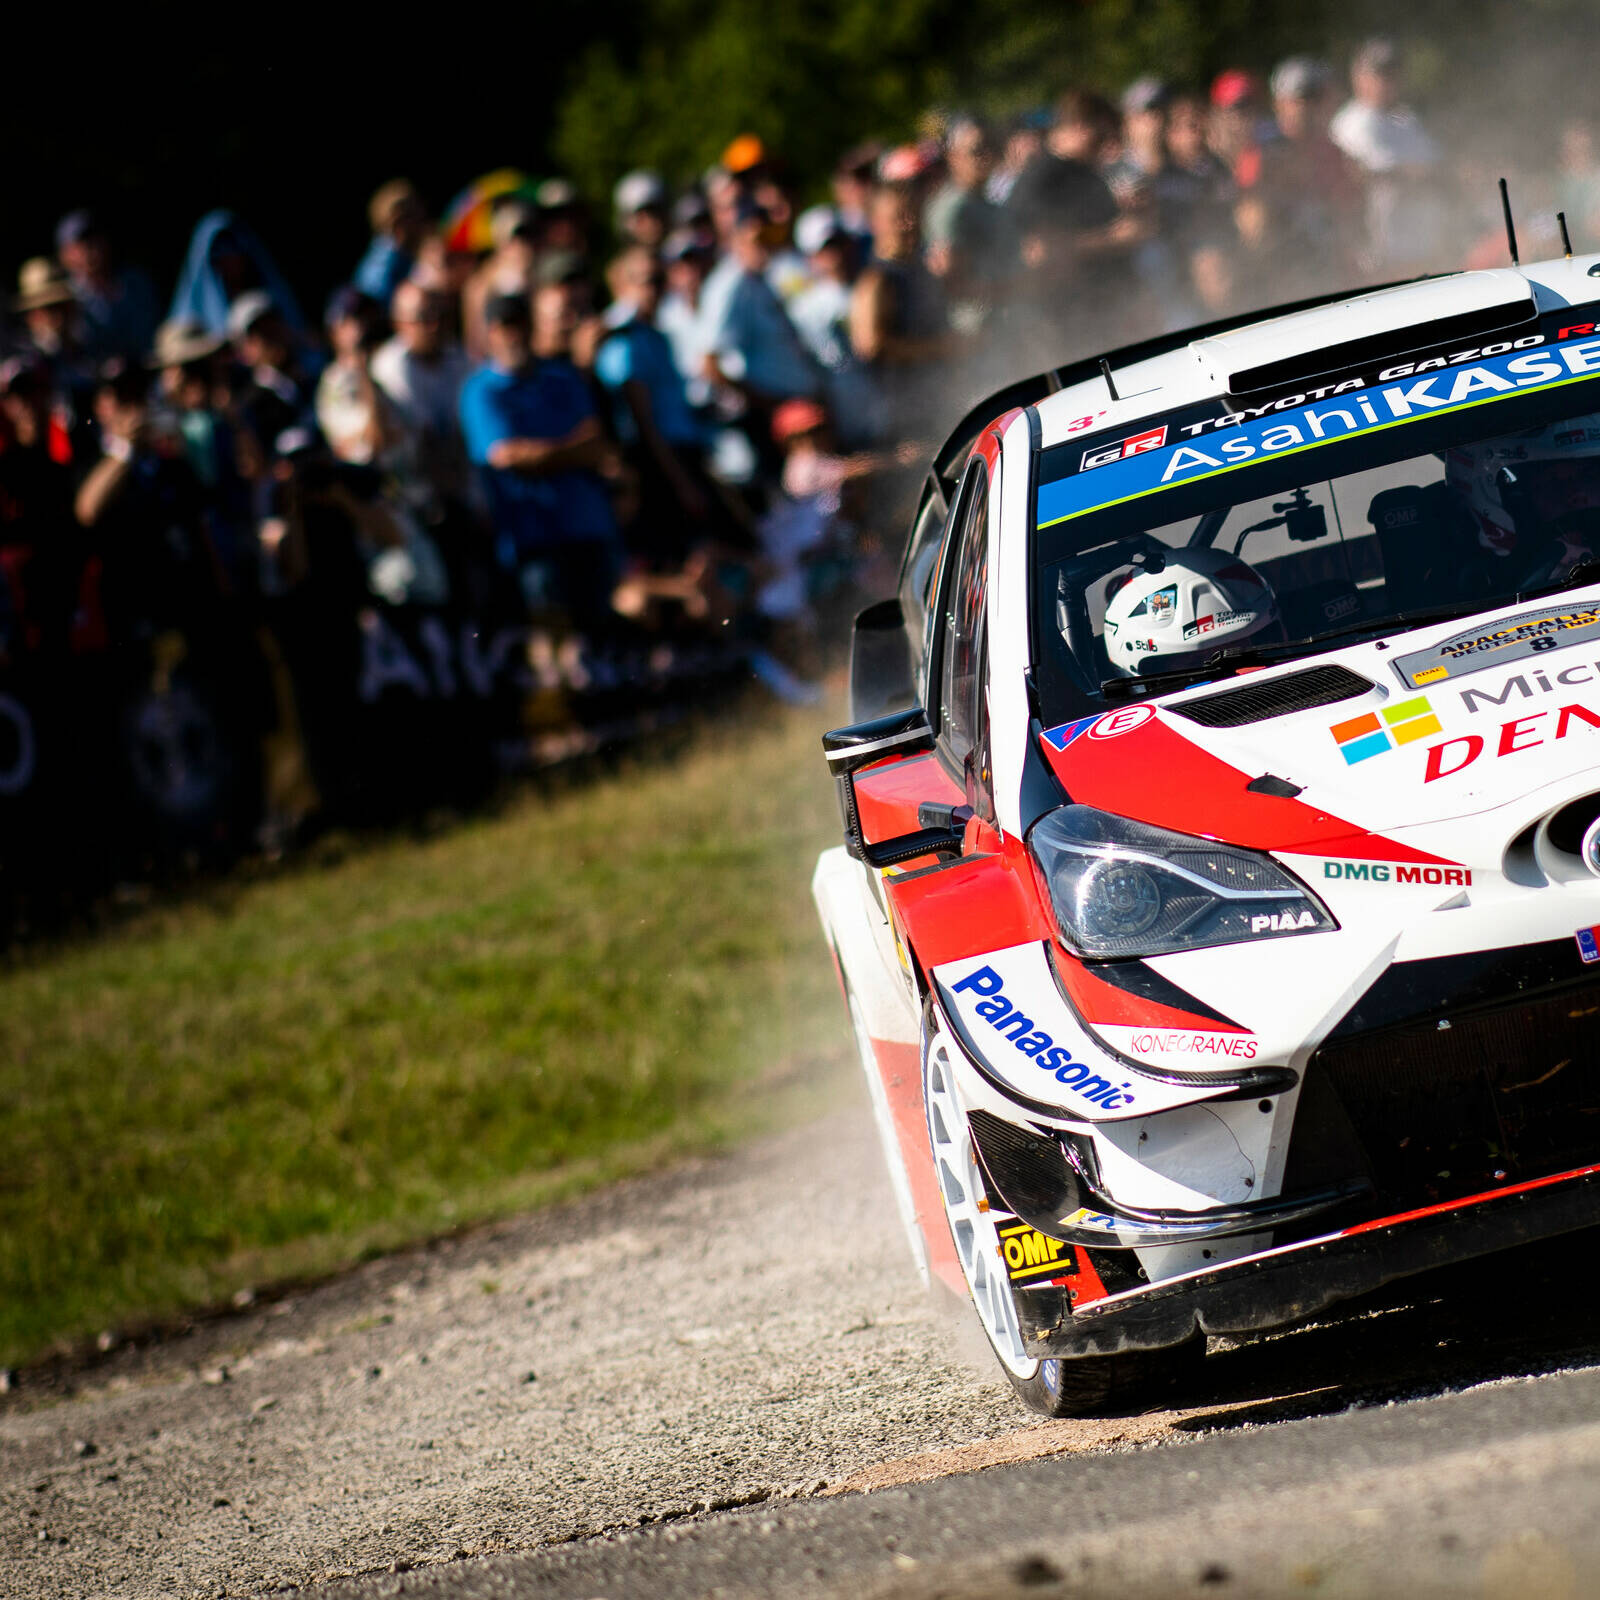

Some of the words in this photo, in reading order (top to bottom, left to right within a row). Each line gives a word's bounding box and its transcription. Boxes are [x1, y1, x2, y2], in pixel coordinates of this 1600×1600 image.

[1082, 434, 1166, 471] GR
[1180, 376, 1366, 435] TOYOTA
[1378, 334, 1546, 382] GAZOO
[1324, 595, 1358, 617] OMP
[1183, 618, 1215, 640] GR
[1452, 617, 1596, 658] DEUTSCHLAND
[1440, 631, 1511, 656] ADAC
[1529, 636, 1558, 651] 8
[1107, 711, 1138, 731] E
[1324, 861, 1390, 882] DMG
[1396, 866, 1472, 887] MORI
[1251, 911, 1317, 933] PIAA
[951, 965, 1136, 1110] Panasonic
[1131, 1033, 1258, 1059] KONECRANES
[1004, 1231, 1065, 1269] OMP
